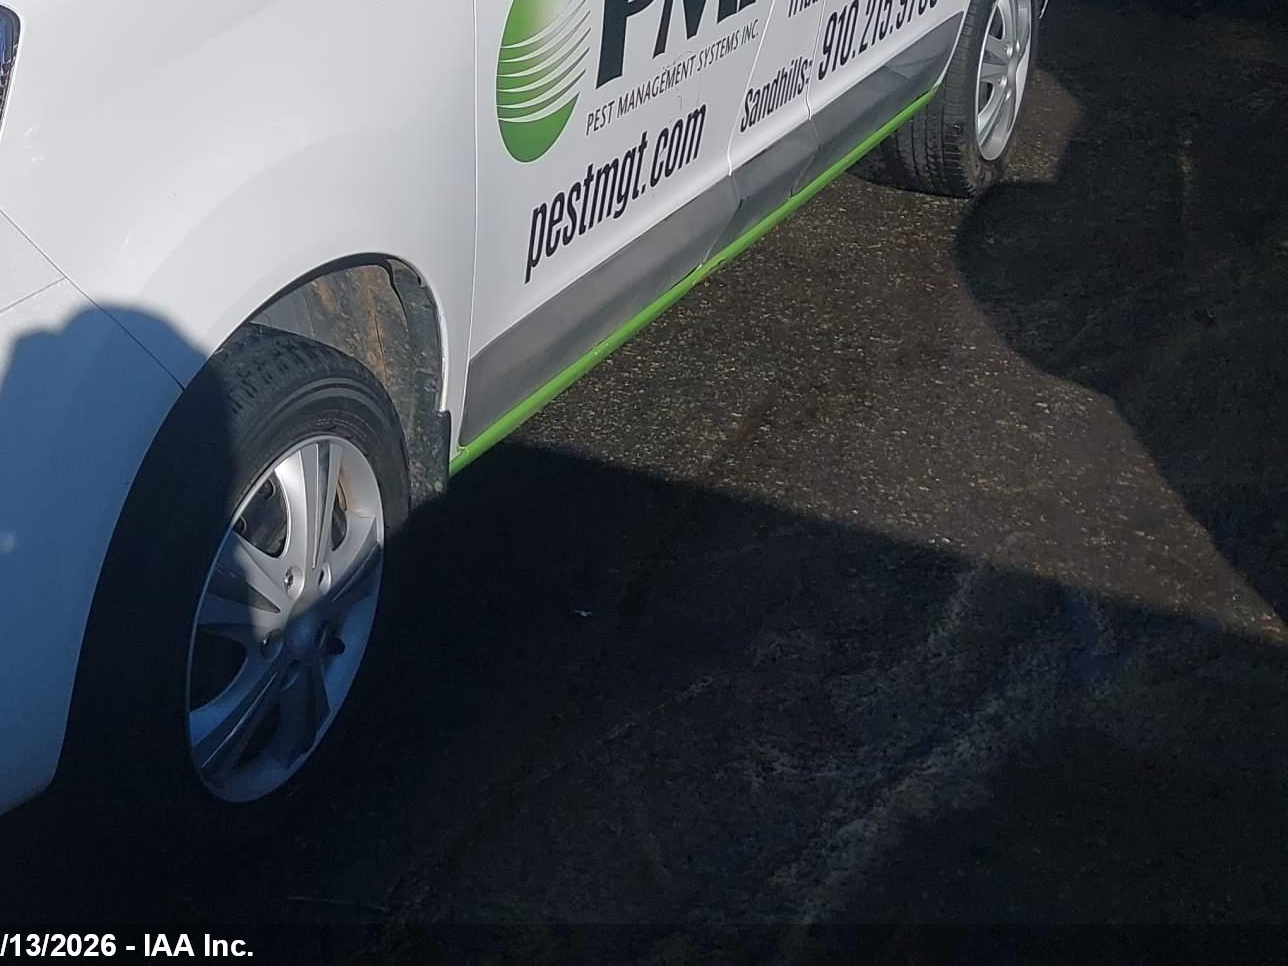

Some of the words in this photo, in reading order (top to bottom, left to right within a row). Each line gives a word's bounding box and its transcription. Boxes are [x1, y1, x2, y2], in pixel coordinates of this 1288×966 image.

[586, 99, 615, 136] PEST
[616, 54, 697, 119] MANAGEMENT
[696, 29, 740, 72] SYSTEMS
[740, 18, 759, 45] INC.
[740, 56, 813, 133] Sandhills:
[524, 103, 707, 285] pestmgt.com
